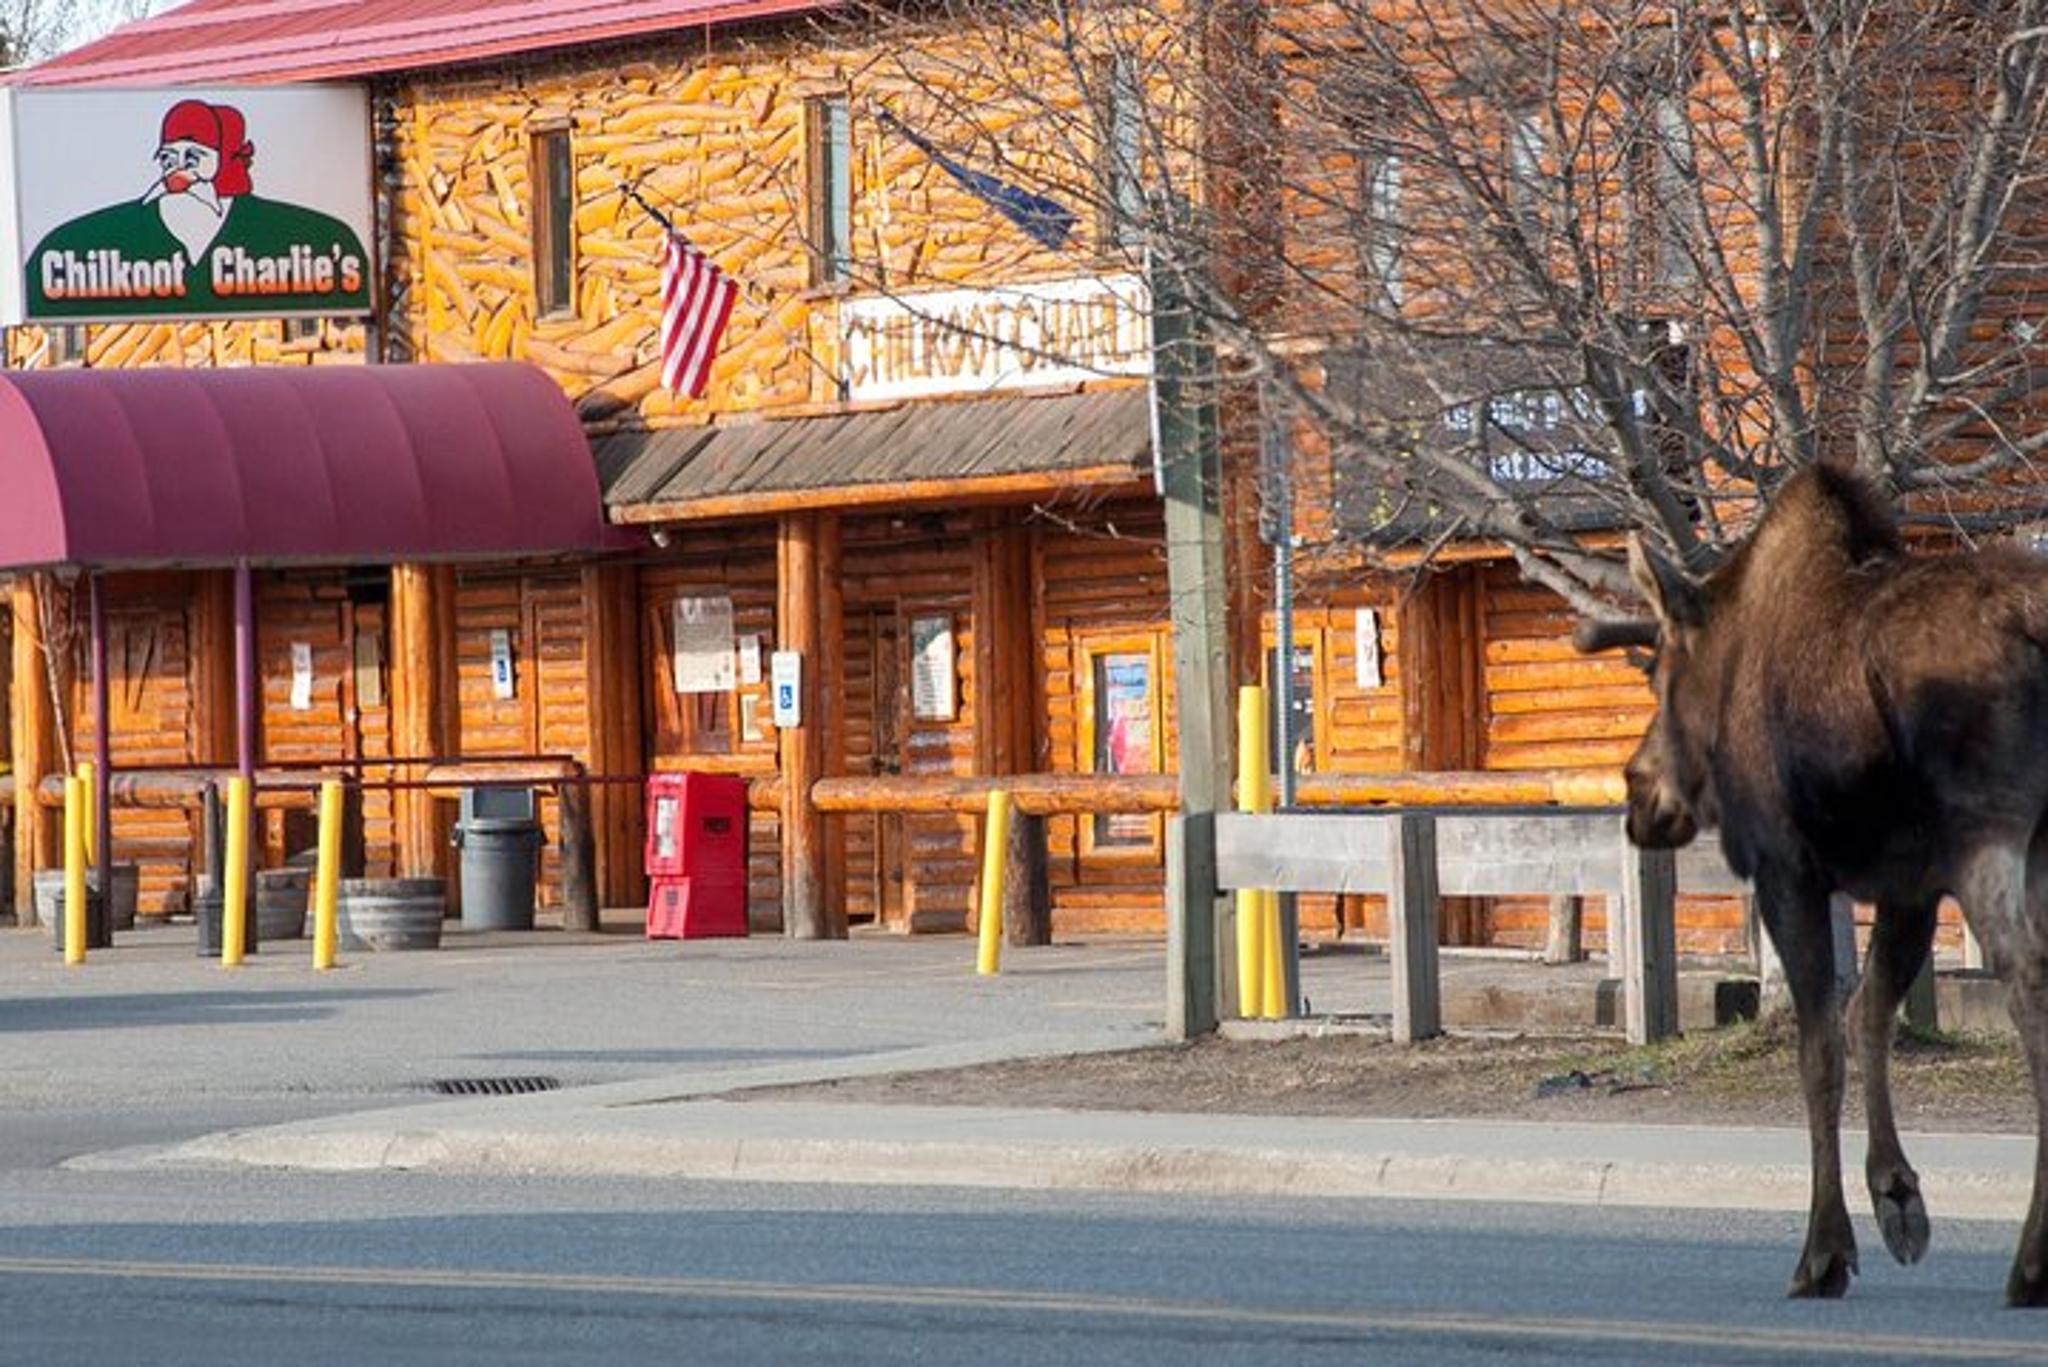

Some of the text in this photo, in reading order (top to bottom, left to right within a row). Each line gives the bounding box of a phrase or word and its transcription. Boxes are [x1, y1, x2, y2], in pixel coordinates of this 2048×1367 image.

[42, 243, 361, 298] Chilkoot Charlie's
[840, 301, 1005, 387] CHILKOOT
